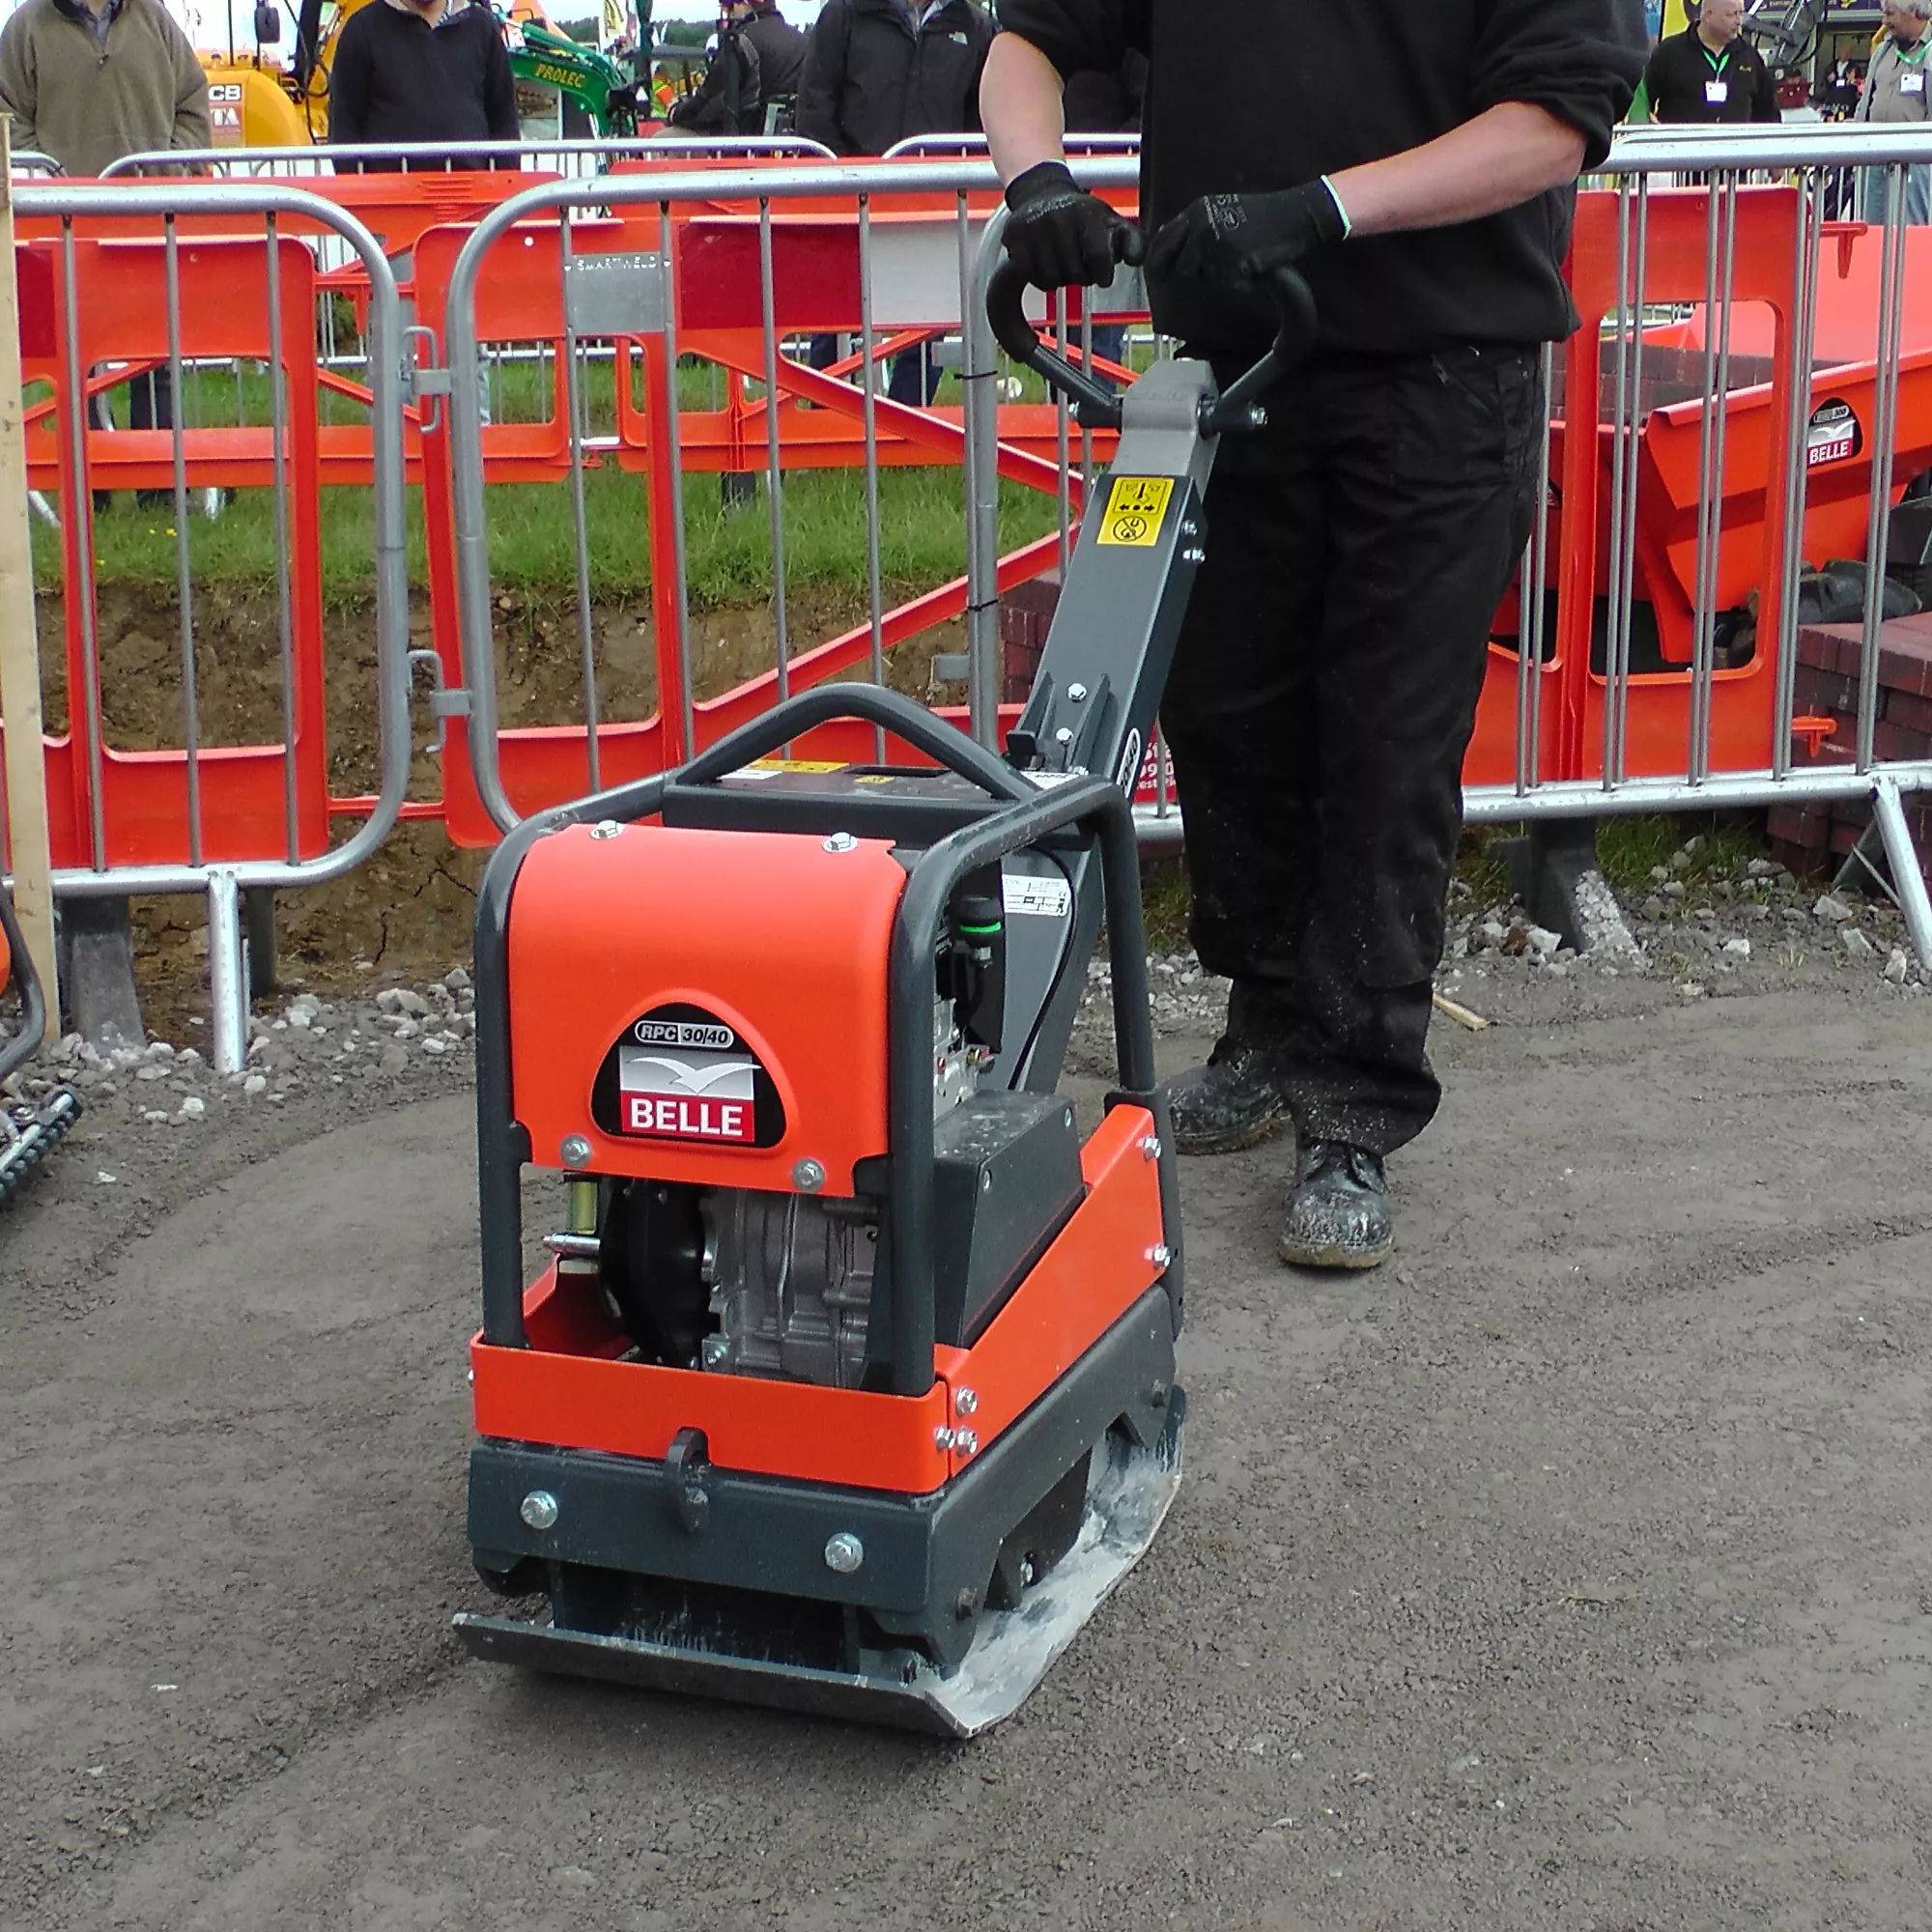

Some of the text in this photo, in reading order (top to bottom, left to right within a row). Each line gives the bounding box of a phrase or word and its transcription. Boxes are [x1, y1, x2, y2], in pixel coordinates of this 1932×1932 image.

[534, 63, 585, 88] PROLEC
[208, 84, 242, 101] CB
[1809, 440, 1850, 465] BELLE
[640, 1024, 728, 1044] RPC 30/40
[630, 1097, 743, 1137] BELLE
